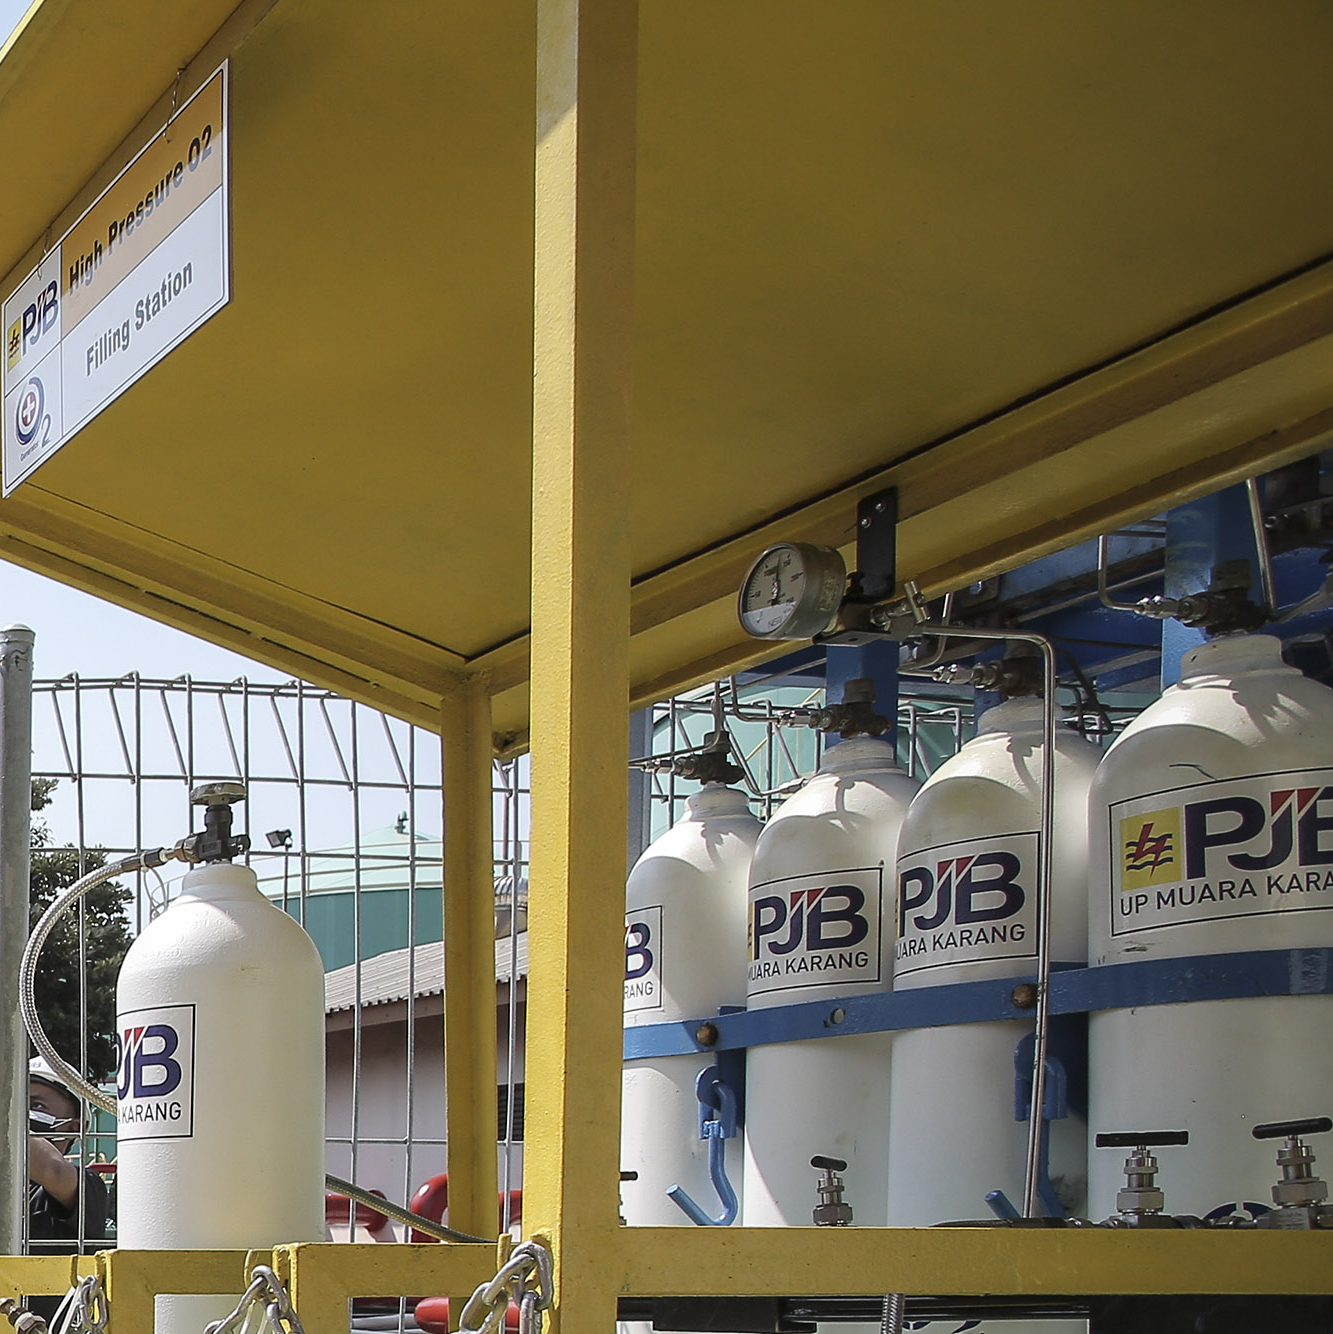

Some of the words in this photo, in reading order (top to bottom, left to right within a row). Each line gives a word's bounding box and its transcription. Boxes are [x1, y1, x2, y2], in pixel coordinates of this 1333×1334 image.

[69, 239, 103, 296] High
[108, 160, 183, 256] Pressure
[22, 280, 60, 357] PJB
[86, 319, 130, 377] Filling
[135, 262, 193, 331] Station
[753, 885, 869, 961] PJB
[899, 851, 1026, 938] PJB
[1120, 894, 1148, 917] UP
[1156, 878, 1257, 910] MUARA
[1267, 871, 1333, 896] KARA
[785, 952, 869, 974] KARANG
[896, 937, 927, 961] UARA
[933, 923, 1026, 952] KARANG
[623, 981, 654, 999] RANG
[121, 1101, 182, 1124] KARANG
